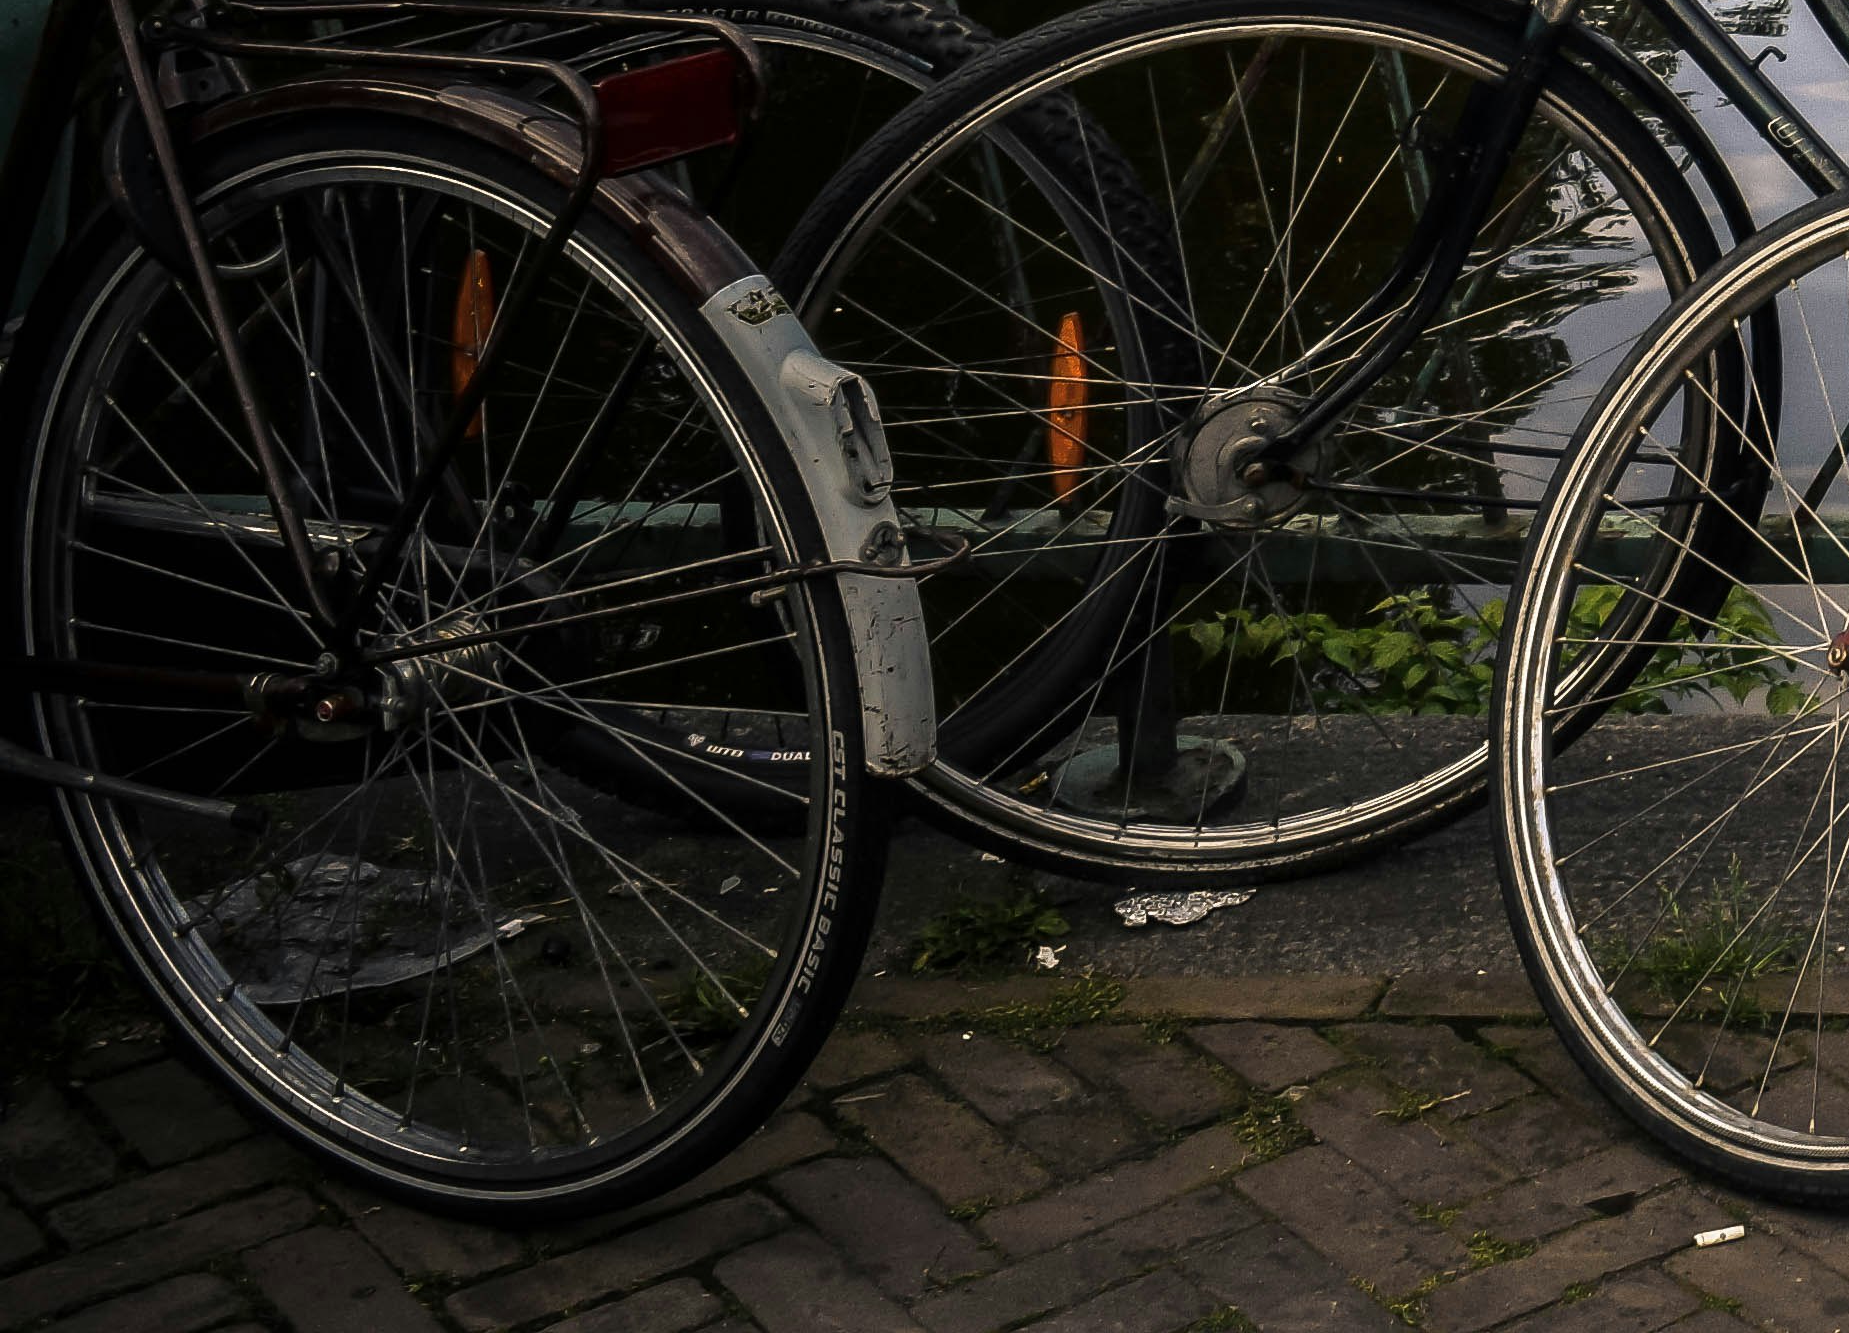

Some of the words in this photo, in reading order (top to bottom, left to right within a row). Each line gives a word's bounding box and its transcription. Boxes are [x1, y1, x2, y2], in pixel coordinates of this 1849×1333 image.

[770, 750, 813, 762] DUAL
[832, 729, 847, 782] CST
[822, 788, 848, 912] CLASSIC
[797, 917, 833, 996] BASIC
